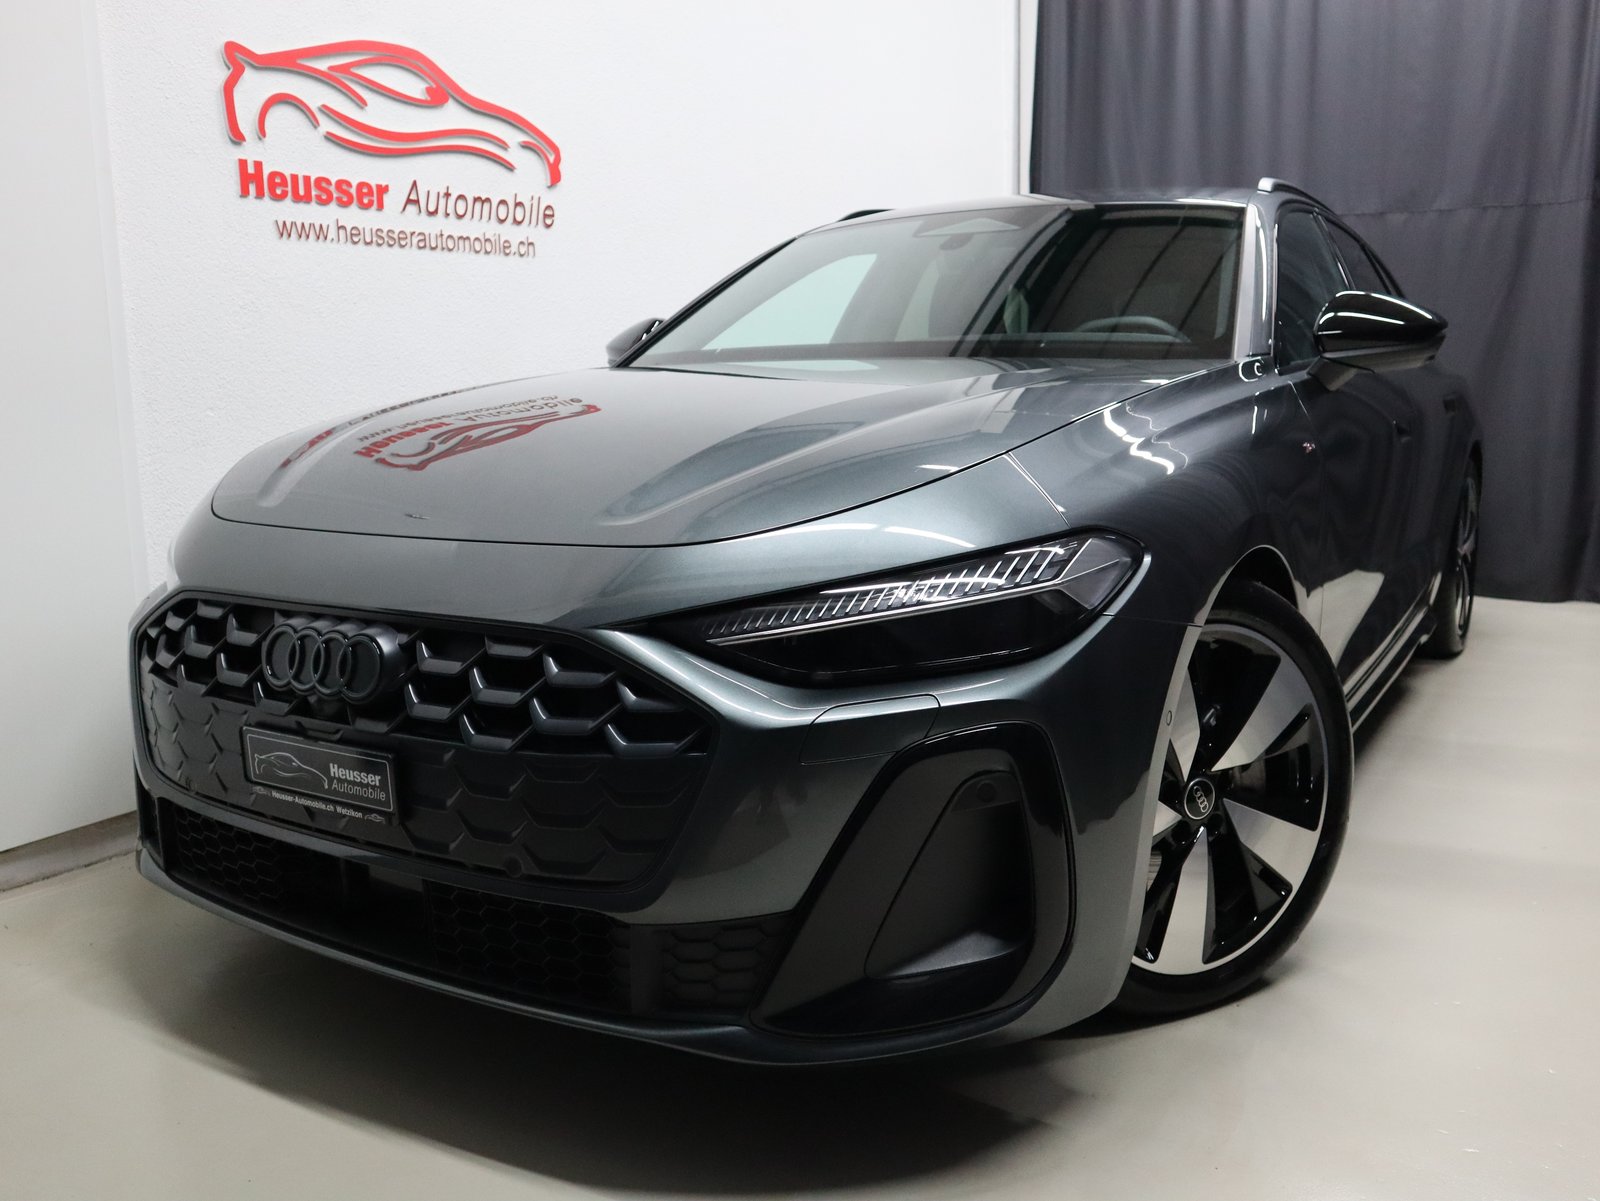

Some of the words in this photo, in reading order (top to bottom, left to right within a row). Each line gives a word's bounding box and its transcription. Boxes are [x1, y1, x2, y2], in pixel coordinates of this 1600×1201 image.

[238, 158, 389, 210] Heusser
[401, 179, 555, 228] Automobile
[275, 218, 536, 258] www.heusserautomobile.ch
[329, 762, 381, 786] Heusser
[271, 790, 335, 812] Heusser-Automobile.ch
[336, 805, 363, 819] Wetzikon
[331, 780, 386, 801] Automobile
